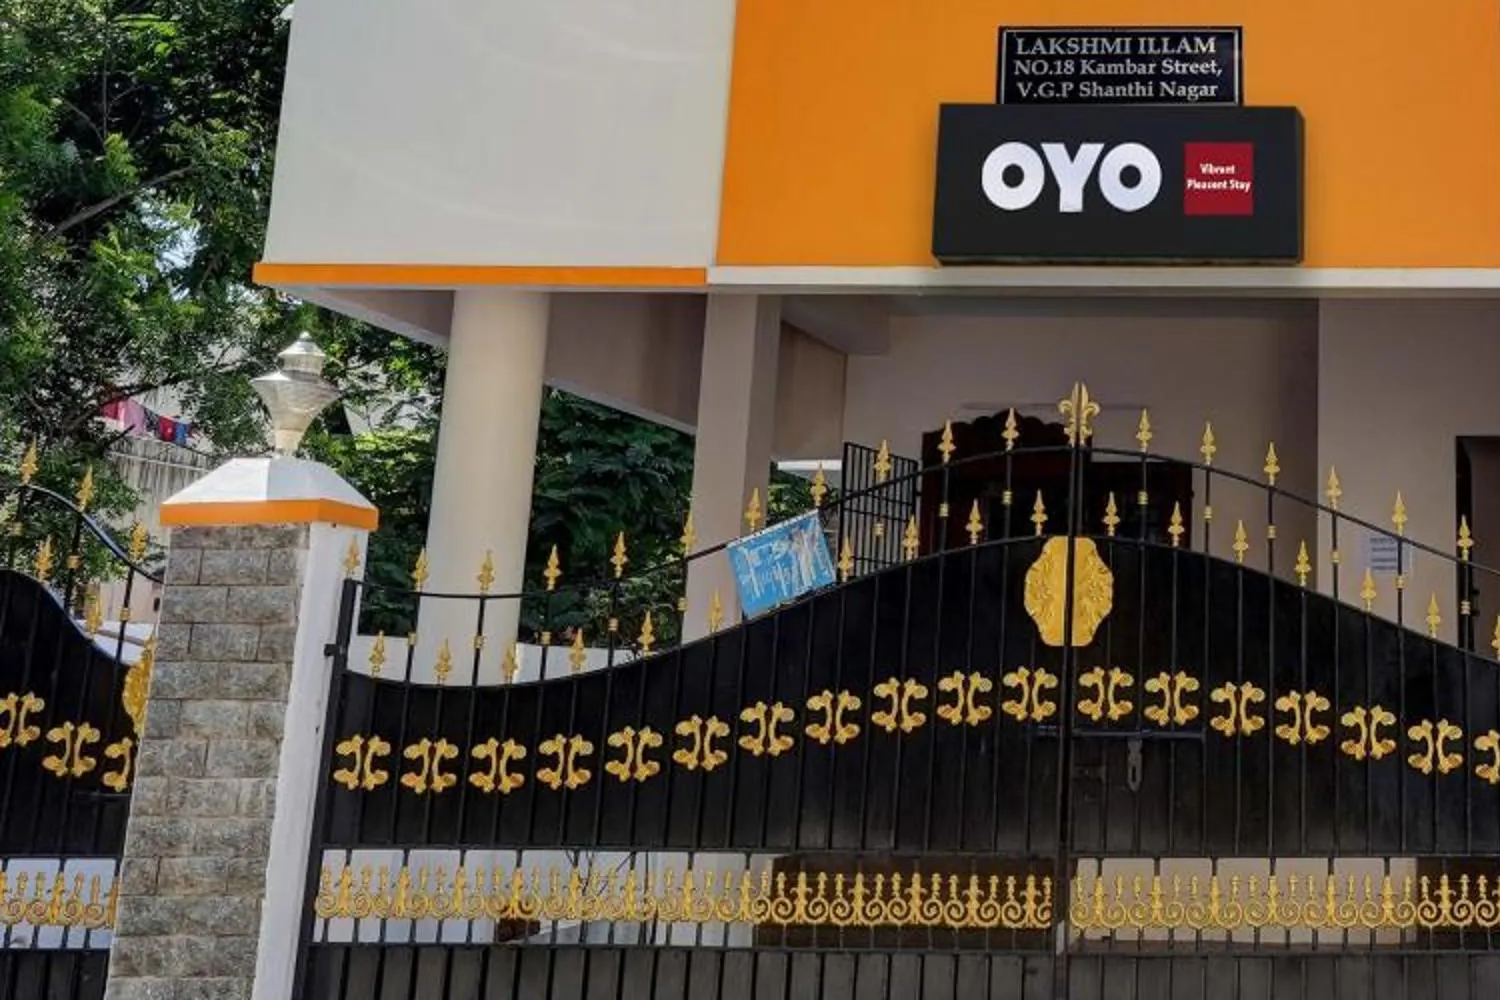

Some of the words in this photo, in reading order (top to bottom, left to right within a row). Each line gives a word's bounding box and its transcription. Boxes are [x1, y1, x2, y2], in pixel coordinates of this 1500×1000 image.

[1016, 37, 1132, 55] LAKSHMI
[1138, 37, 1216, 55] ILLAM
[1014, 59, 1075, 76] NO.18
[1080, 58, 1156, 75] Kambar
[1161, 58, 1223, 77] Street,
[1016, 81, 1074, 98] V.G.P
[1079, 81, 1154, 97] Shanthi
[1160, 81, 1218, 101] Nagar
[981, 141, 1162, 213] OYO
[1200, 163, 1235, 174] Vibrant
[1187, 179, 1227, 190] Pleasant
[1229, 179, 1251, 193] Stay
